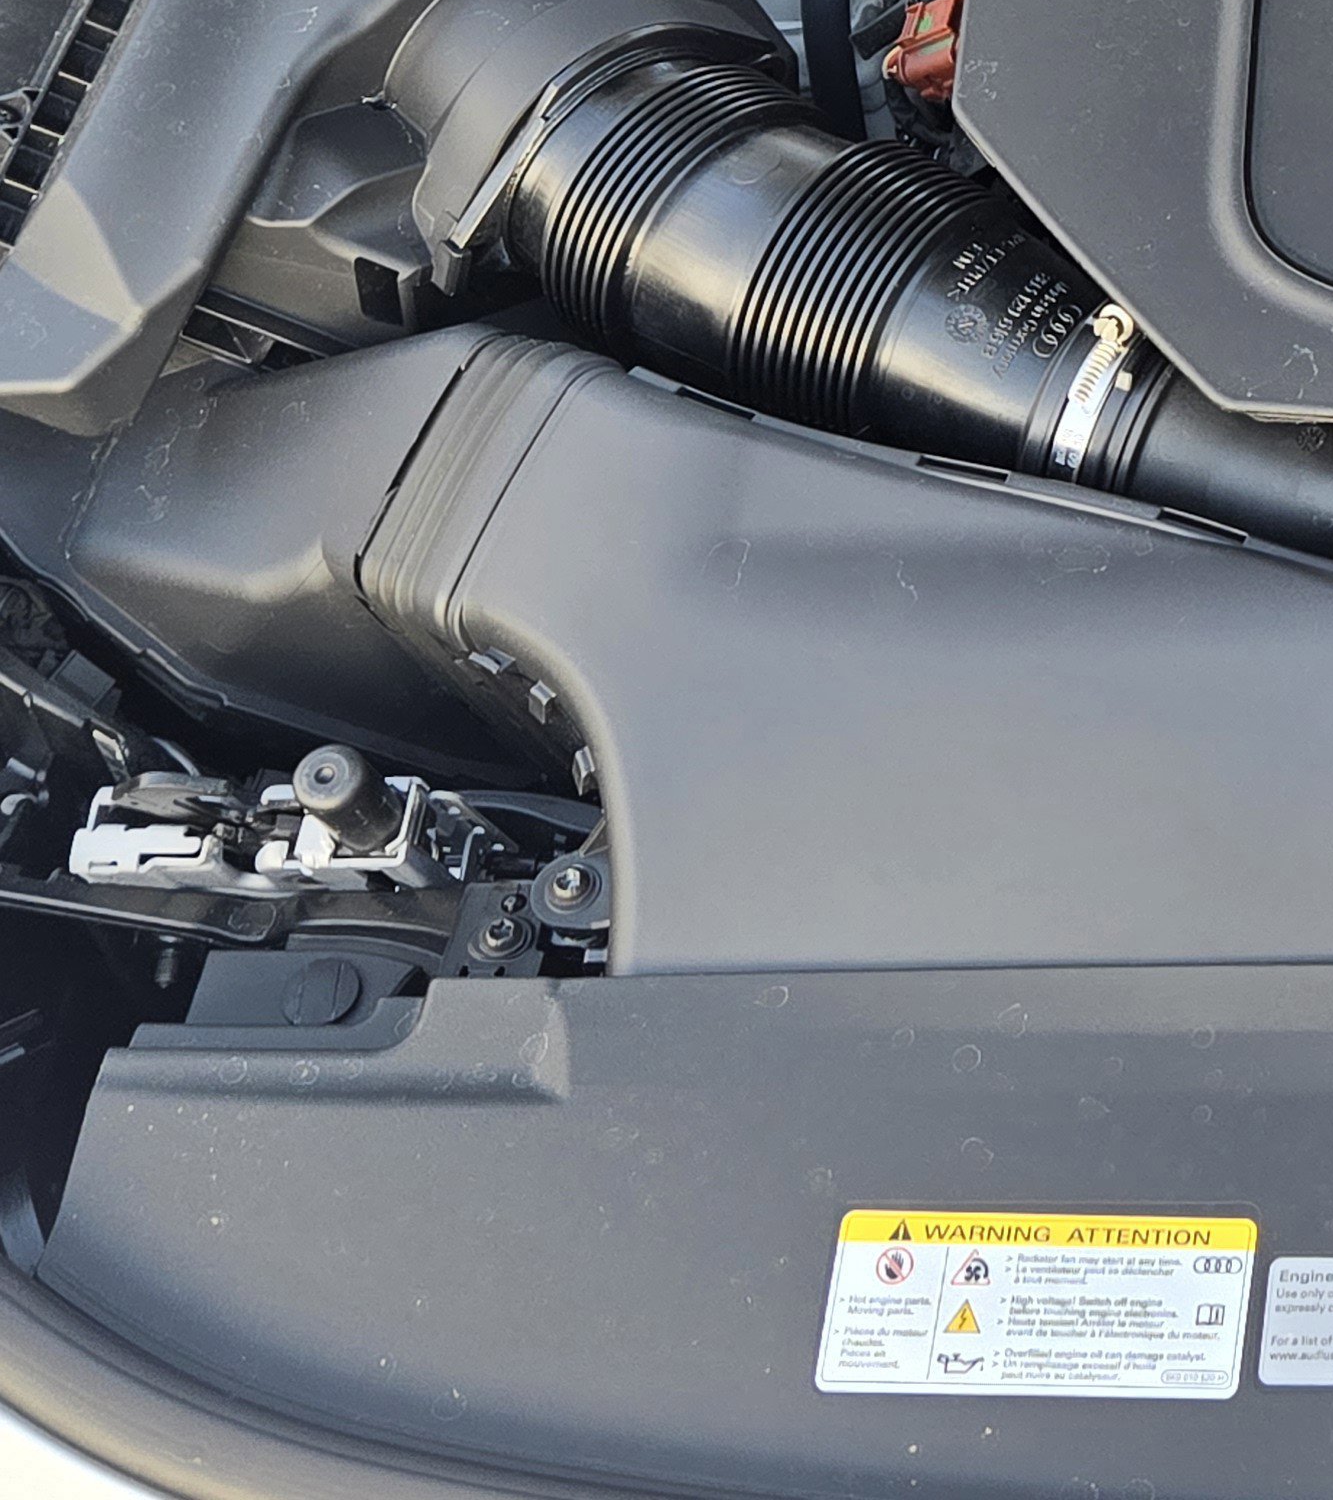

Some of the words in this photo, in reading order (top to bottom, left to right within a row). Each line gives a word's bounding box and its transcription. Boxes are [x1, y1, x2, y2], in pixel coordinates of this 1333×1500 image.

[925, 1223, 1050, 1242] WARNING
[1067, 1227, 1210, 1246] ATTENTION
[1062, 1256, 1075, 1264] fan
[1279, 1270, 1333, 1284] Engine
[1276, 1289, 1298, 1298] Use
[1301, 1289, 1325, 1300] only
[869, 1296, 902, 1306] engine
[1012, 1296, 1033, 1306] High
[1036, 1296, 1076, 1307] voltage!
[1079, 1297, 1111, 1306] Switch
[1114, 1297, 1127, 1307] off
[1130, 1300, 1162, 1309] engine
[1275, 1303, 1325, 1313] expressly
[1089, 1309, 1121, 1319] engine
[1271, 1336, 1289, 1345] For
[1301, 1336, 1317, 1345] list
[1321, 1336, 1333, 1345] of
[1055, 1350, 1088, 1360] engine
[1090, 1350, 1103, 1359] oil
[1125, 1351, 1164, 1361] damage
